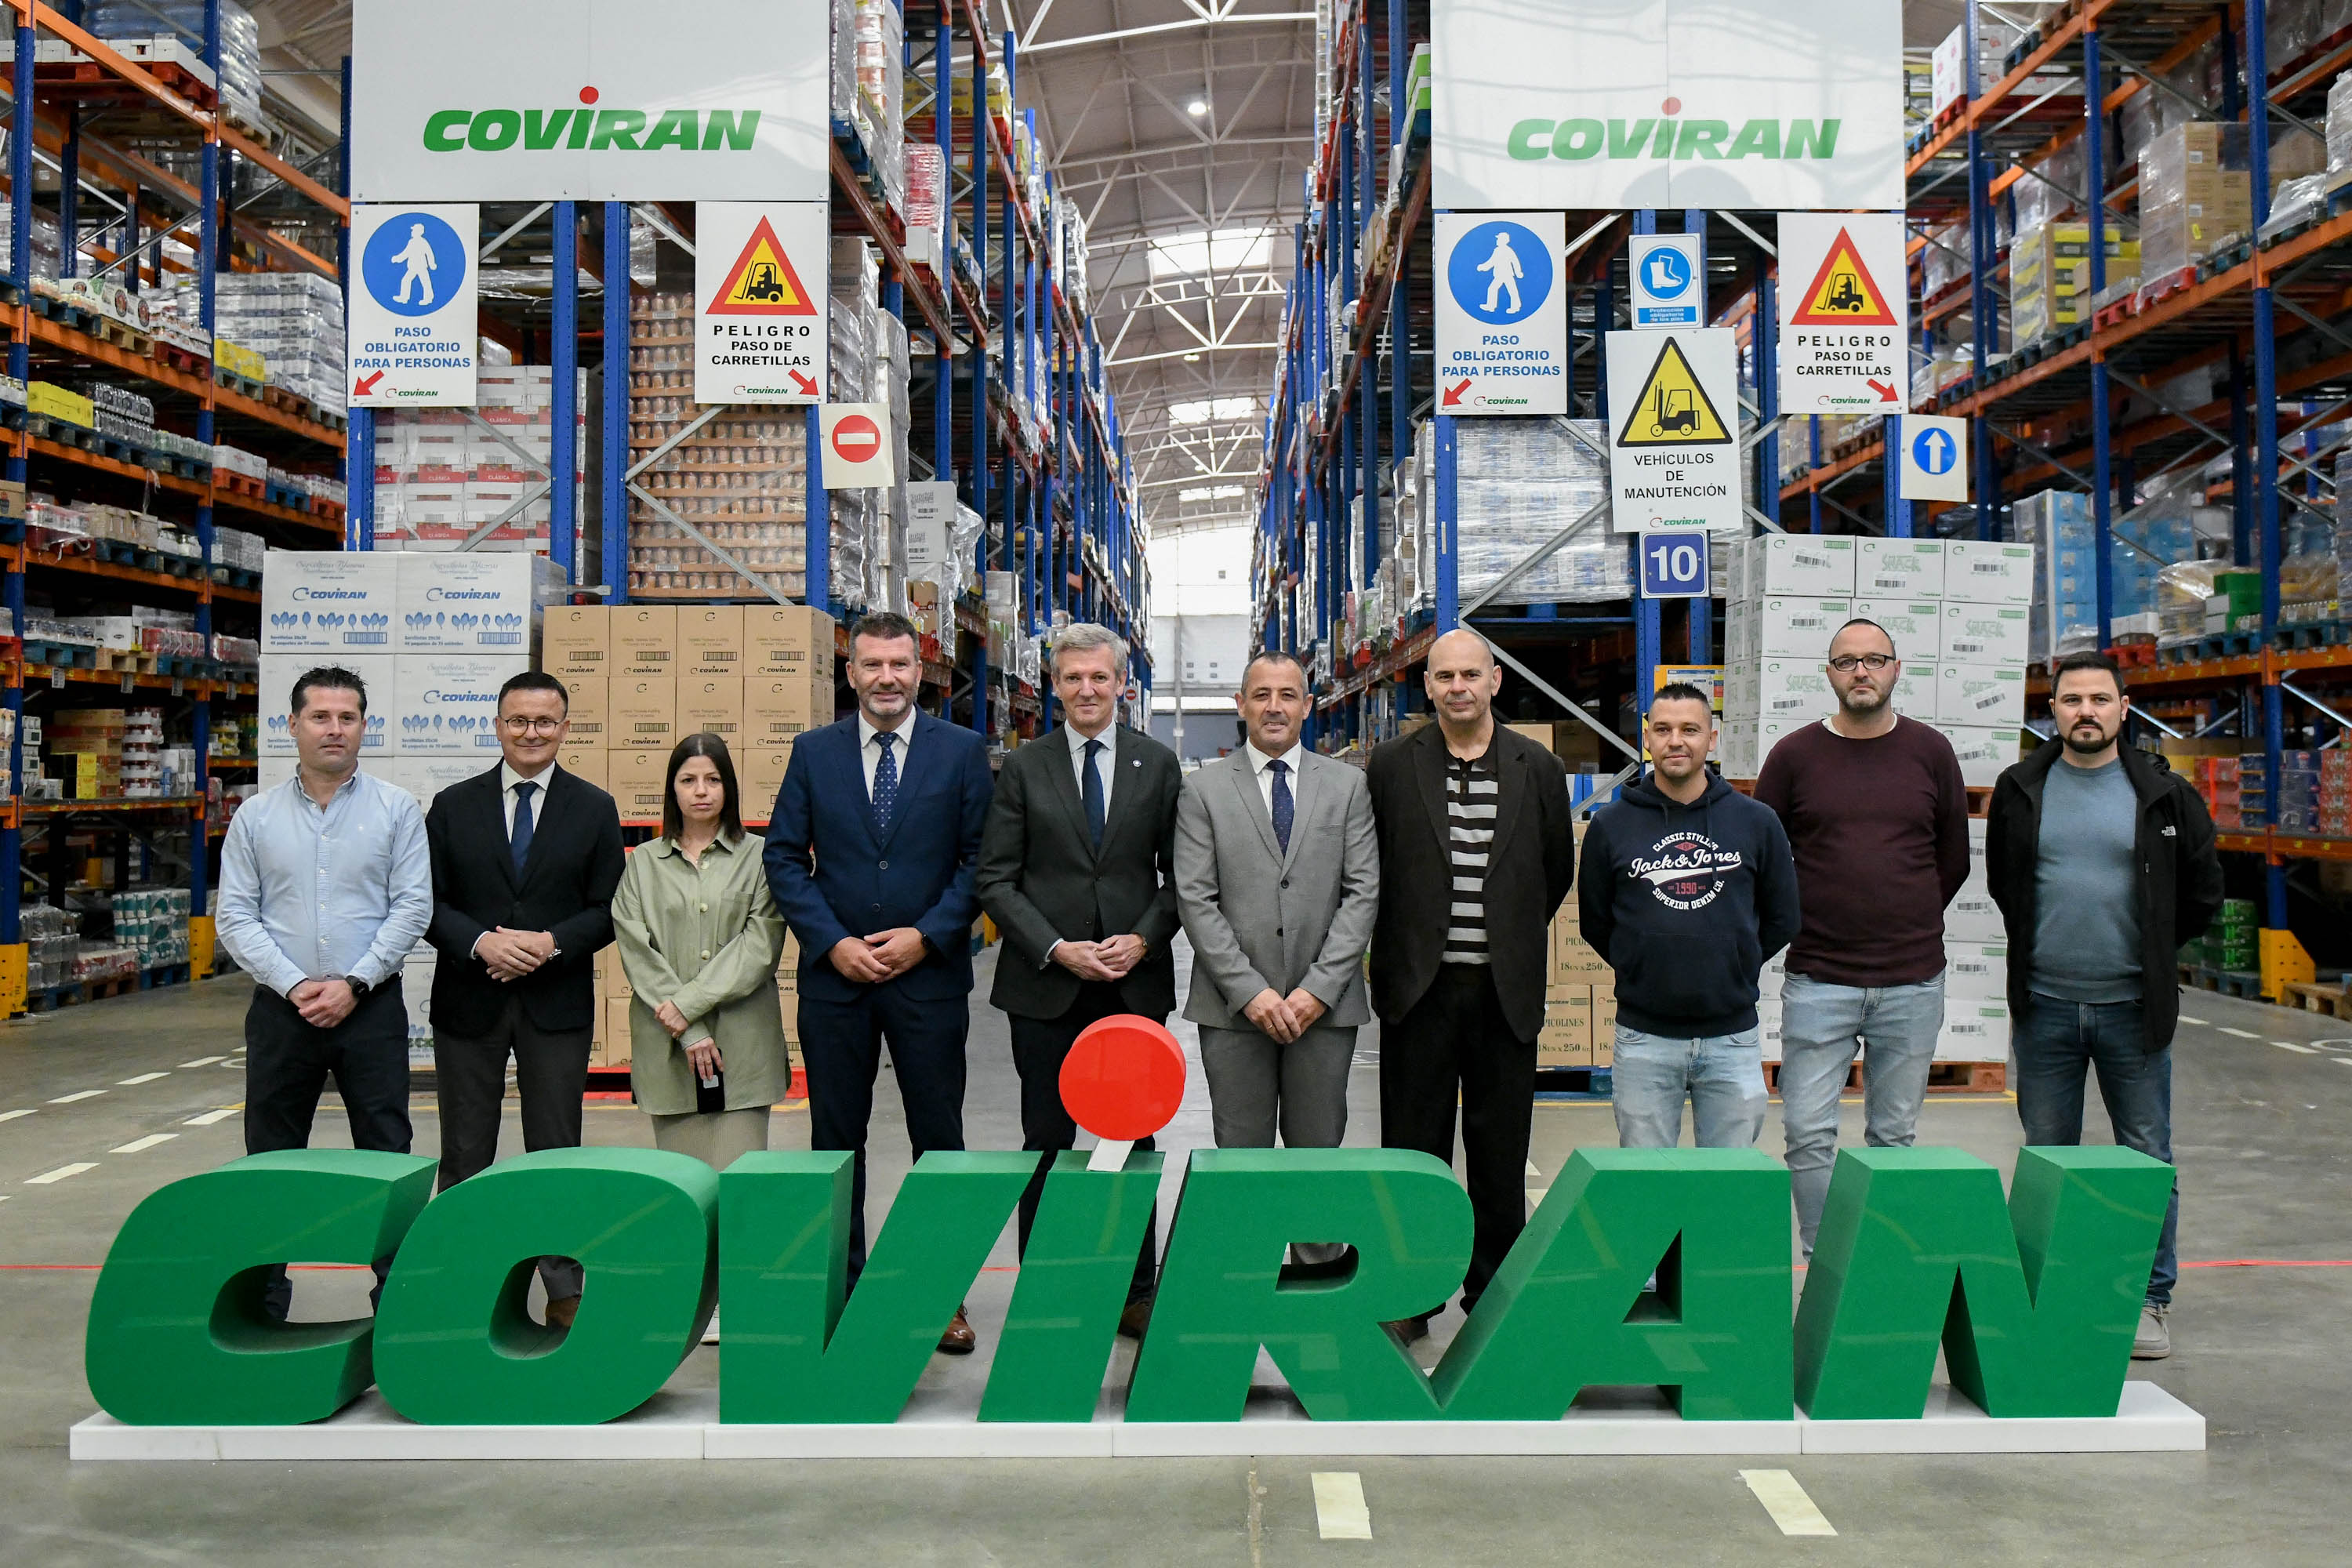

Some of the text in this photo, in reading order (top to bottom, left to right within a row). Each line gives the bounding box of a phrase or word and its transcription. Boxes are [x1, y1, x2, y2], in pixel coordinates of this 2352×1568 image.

[423, 86, 761, 152] COVIRAN
[1507, 96, 1841, 161] COVIRAN
[394, 327, 431, 337] PASO
[713, 325, 811, 336] PELIGRO
[1482, 336, 1519, 345] PASO
[1798, 336, 1891, 347] PELIGRO
[365, 342, 460, 353] OBLIGATORIO
[731, 342, 793, 351] PASO DE
[711, 355, 811, 366] CARRETILLAS
[1452, 350, 1549, 361] OBLIGATORIO
[1815, 351, 1874, 361] PASO DE
[354, 358, 471, 368] PARA PERSONAS
[1442, 365, 1560, 376] PARA PERSONAS
[1796, 365, 1892, 376] CARRETILLAS
[398, 388, 438, 397] COVIRAN
[747, 386, 788, 394] COVIRAN
[1486, 396, 1528, 405] COVIRAN
[1831, 395, 1871, 405] COVIRAN
[1634, 452, 1714, 466] VEHÍCULOS
[1666, 470, 1684, 481] DE
[1624, 483, 1726, 499] MANUTENCIÓN
[1664, 517, 1706, 526] COVIRAN
[1650, 545, 1698, 582] 10
[310, 588, 367, 599] COVIRAN
[445, 588, 501, 600] COVIRAN
[441, 690, 499, 702] COVIRAN
[1652, 832, 1685, 852] CLASSIC
[1675, 882, 1697, 895] 1990
[1652, 887, 1690, 910] SUPERIOR
[1690, 890, 1716, 909] DENIM
[1586, 962, 1602, 971] 250
[85, 1013, 2177, 1425] COVIRAN
